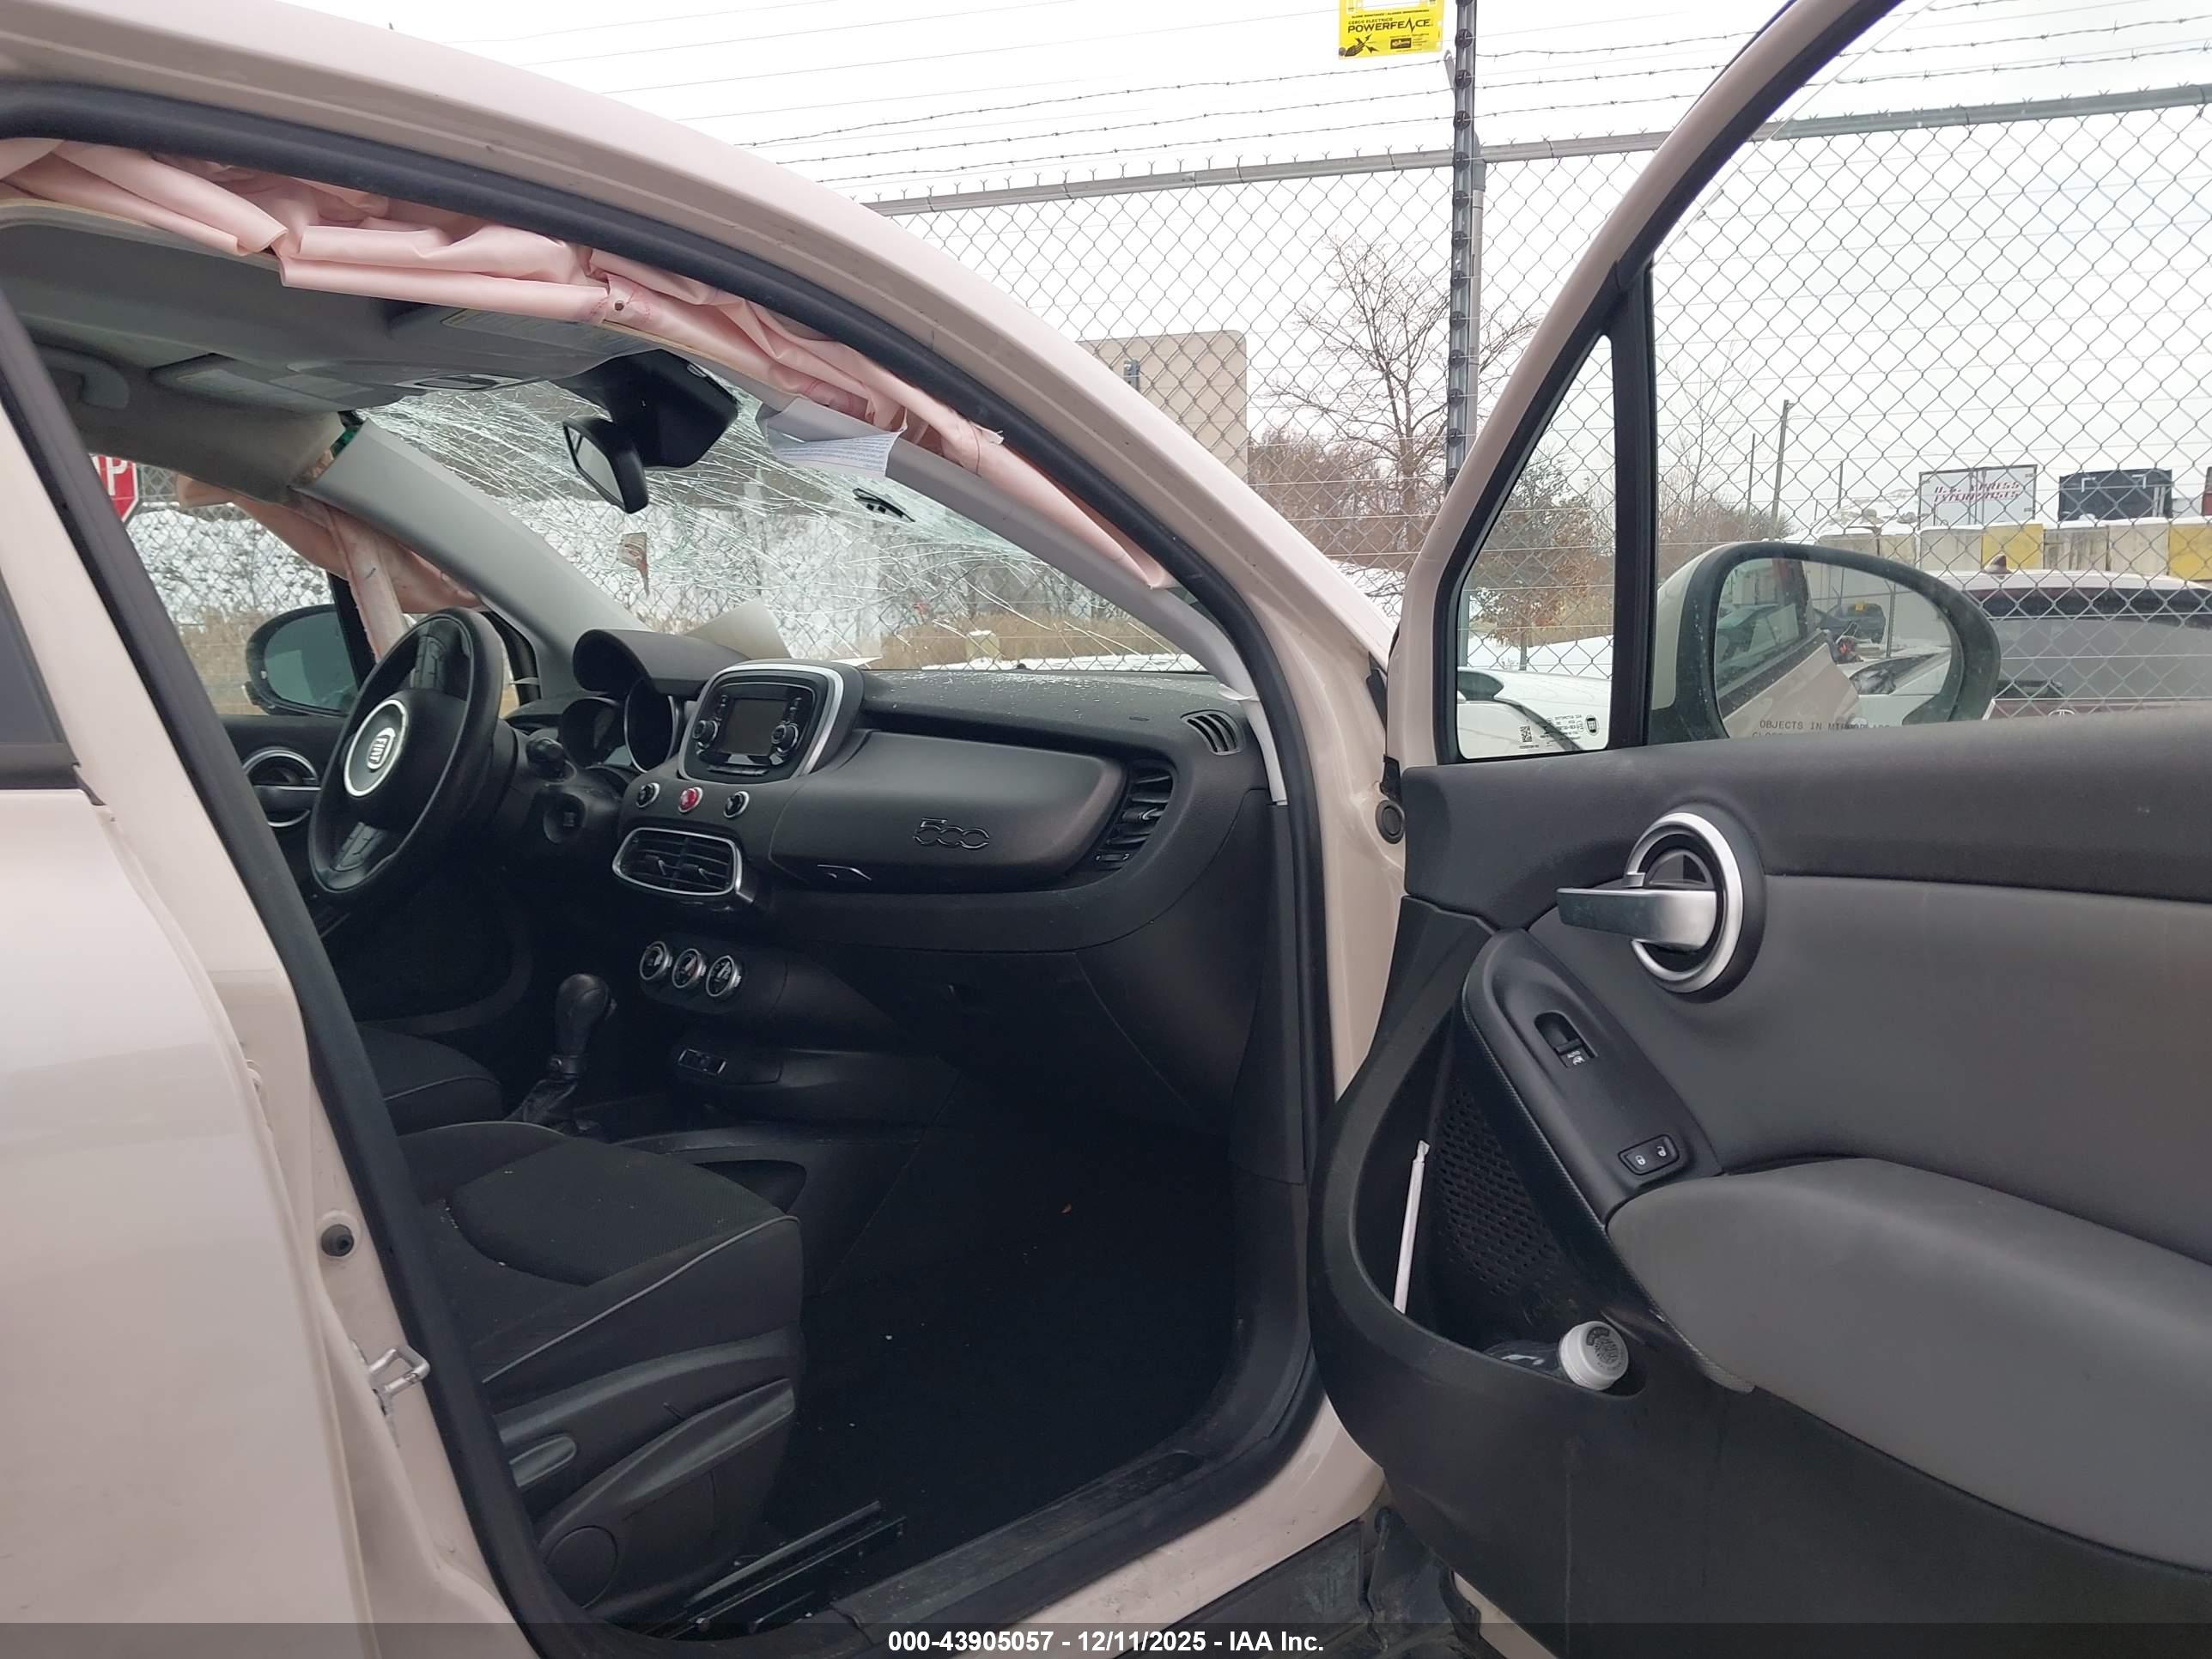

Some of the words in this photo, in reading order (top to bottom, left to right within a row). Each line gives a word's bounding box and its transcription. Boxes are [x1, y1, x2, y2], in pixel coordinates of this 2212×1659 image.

[1759, 720, 1804, 730] OBJECTS
[1810, 721, 1822, 731] IN
[368, 738, 388, 762] FIAT
[912, 817, 990, 848] 500
